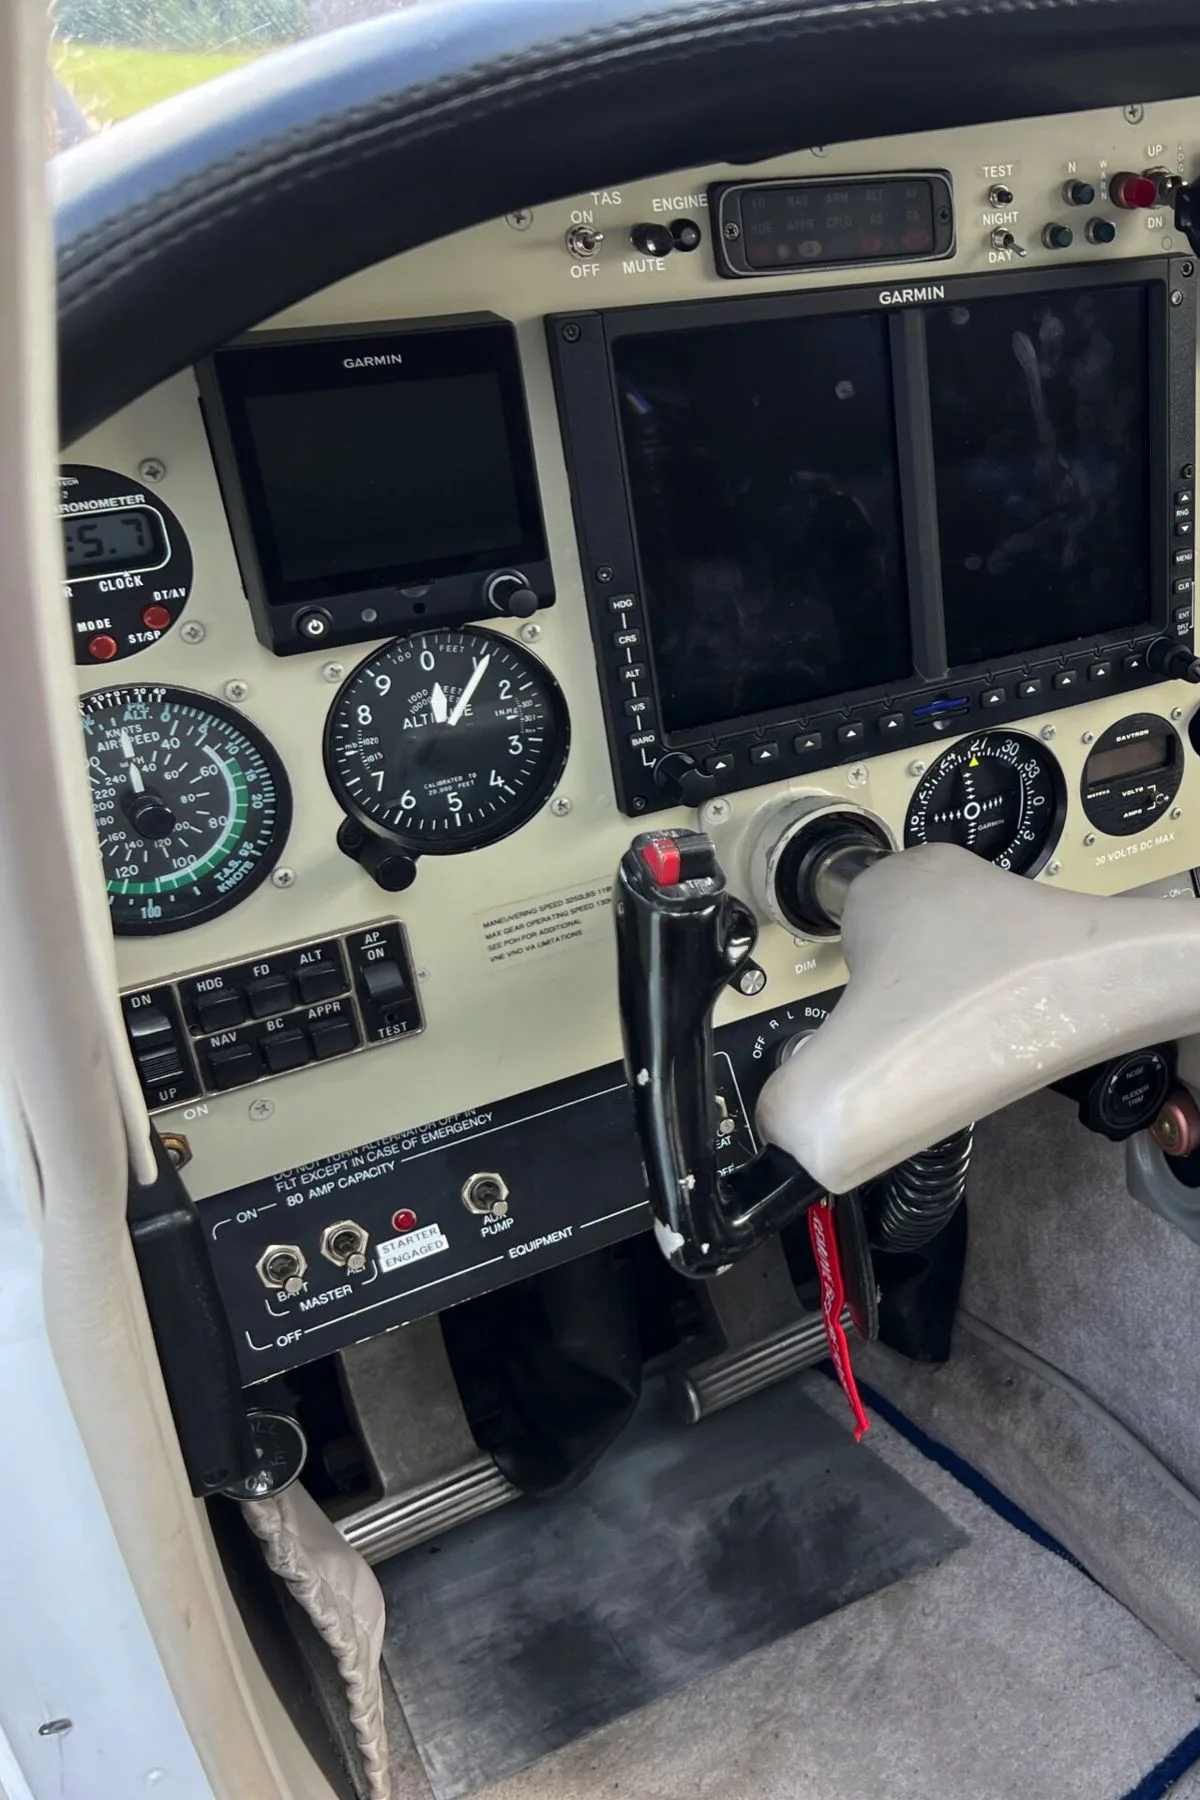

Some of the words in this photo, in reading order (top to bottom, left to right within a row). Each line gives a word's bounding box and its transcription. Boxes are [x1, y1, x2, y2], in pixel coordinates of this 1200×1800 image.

[1148, 145, 1163, 157] UP
[982, 164, 1013, 178] TEST
[591, 192, 621, 206] TAS
[652, 194, 708, 213] ENGINE
[571, 210, 594, 225] ON
[982, 211, 1019, 226] NIGHT
[1147, 216, 1163, 229] DN
[988, 250, 1013, 264] DAY
[570, 264, 600, 279] OFF
[623, 258, 666, 275] MUTE
[879, 285, 945, 305] GARMIN
[343, 353, 403, 370] GARMIN
[1176, 508, 1189, 517] RNG
[1176, 553, 1192, 562] MENU
[99, 576, 144, 592] CLOCK
[1178, 582, 1190, 591] CLR
[154, 588, 187, 602] DT/AV
[613, 599, 633, 609] HDG
[1178, 610, 1190, 620] ENT
[77, 618, 112, 632] MODE
[128, 630, 161, 644] ST/SP
[618, 634, 637, 645] CRS
[439, 645, 465, 653] FEET
[625, 669, 640, 679] ALT
[407, 688, 428, 705] 1000
[631, 702, 646, 713] V/S
[161, 737, 181, 750] 40
[631, 733, 655, 746] BARO
[1116, 729, 1150, 743] DAVTRON
[1001, 739, 1020, 757] 30
[142, 763, 157, 773] 40
[164, 770, 179, 780] 60
[199, 765, 219, 777] 60
[1024, 759, 1041, 779] 33
[105, 774, 127, 786] 240
[424, 775, 464, 790] CALIBRATED
[467, 771, 478, 780] TO
[457, 780, 475, 790] FEET
[94, 788, 116, 799] 220
[180, 793, 196, 804] 80
[1122, 786, 1145, 798] VOLTS
[401, 790, 416, 810] 6
[447, 791, 463, 811] 5
[1123, 808, 1143, 819] AMPS
[208, 815, 228, 829] 80
[108, 831, 127, 843] 160
[124, 838, 144, 850] 140
[154, 837, 172, 848] 120
[1107, 844, 1138, 863] VOLTS
[1140, 839, 1154, 852] DC
[1154, 832, 1176, 849] MAX
[172, 854, 197, 869] 100
[115, 864, 139, 879] 120
[216, 860, 255, 894] KNOTS
[483, 907, 538, 928] MANEUVERING
[539, 900, 565, 912] SPEED
[485, 929, 502, 941] MAX
[503, 923, 525, 935] GEAR
[526, 910, 570, 929] OPERATING
[570, 902, 595, 915] SPEED
[539, 919, 582, 936] ADDITIONAL
[363, 931, 381, 945] AP
[536, 929, 583, 949] LIMITATIONS
[300, 950, 323, 965] ALT
[367, 948, 385, 961] ON
[253, 964, 270, 977] FD
[795, 958, 818, 975] DIM
[196, 977, 224, 993] HDG
[131, 994, 151, 1009] DN
[307, 1001, 341, 1020] APPR
[266, 1018, 284, 1032] BC
[377, 1021, 409, 1039] TEST
[210, 1031, 238, 1048] NAV
[752, 1035, 766, 1059] OFF
[159, 1087, 177, 1102] UP
[183, 1104, 209, 1120] ON
[275, 1177, 298, 1193] FLT
[300, 1160, 349, 1185] EXCEPT
[351, 1156, 365, 1169] IN
[367, 1144, 401, 1163] CASE
[401, 1137, 419, 1151] OF
[421, 1111, 494, 1145] EMERGENCY
[286, 1192, 304, 1208] 80
[308, 1180, 336, 1201] AMP
[337, 1159, 397, 1190] CAPACITY
[236, 1208, 259, 1225] ON
[480, 1217, 515, 1239] PUMP
[381, 1227, 438, 1254] STARTER
[508, 1226, 575, 1260] EQUIPMENT
[384, 1239, 445, 1270] ENGAGED
[300, 1283, 354, 1313] MASTER
[276, 1329, 304, 1348] OFF
